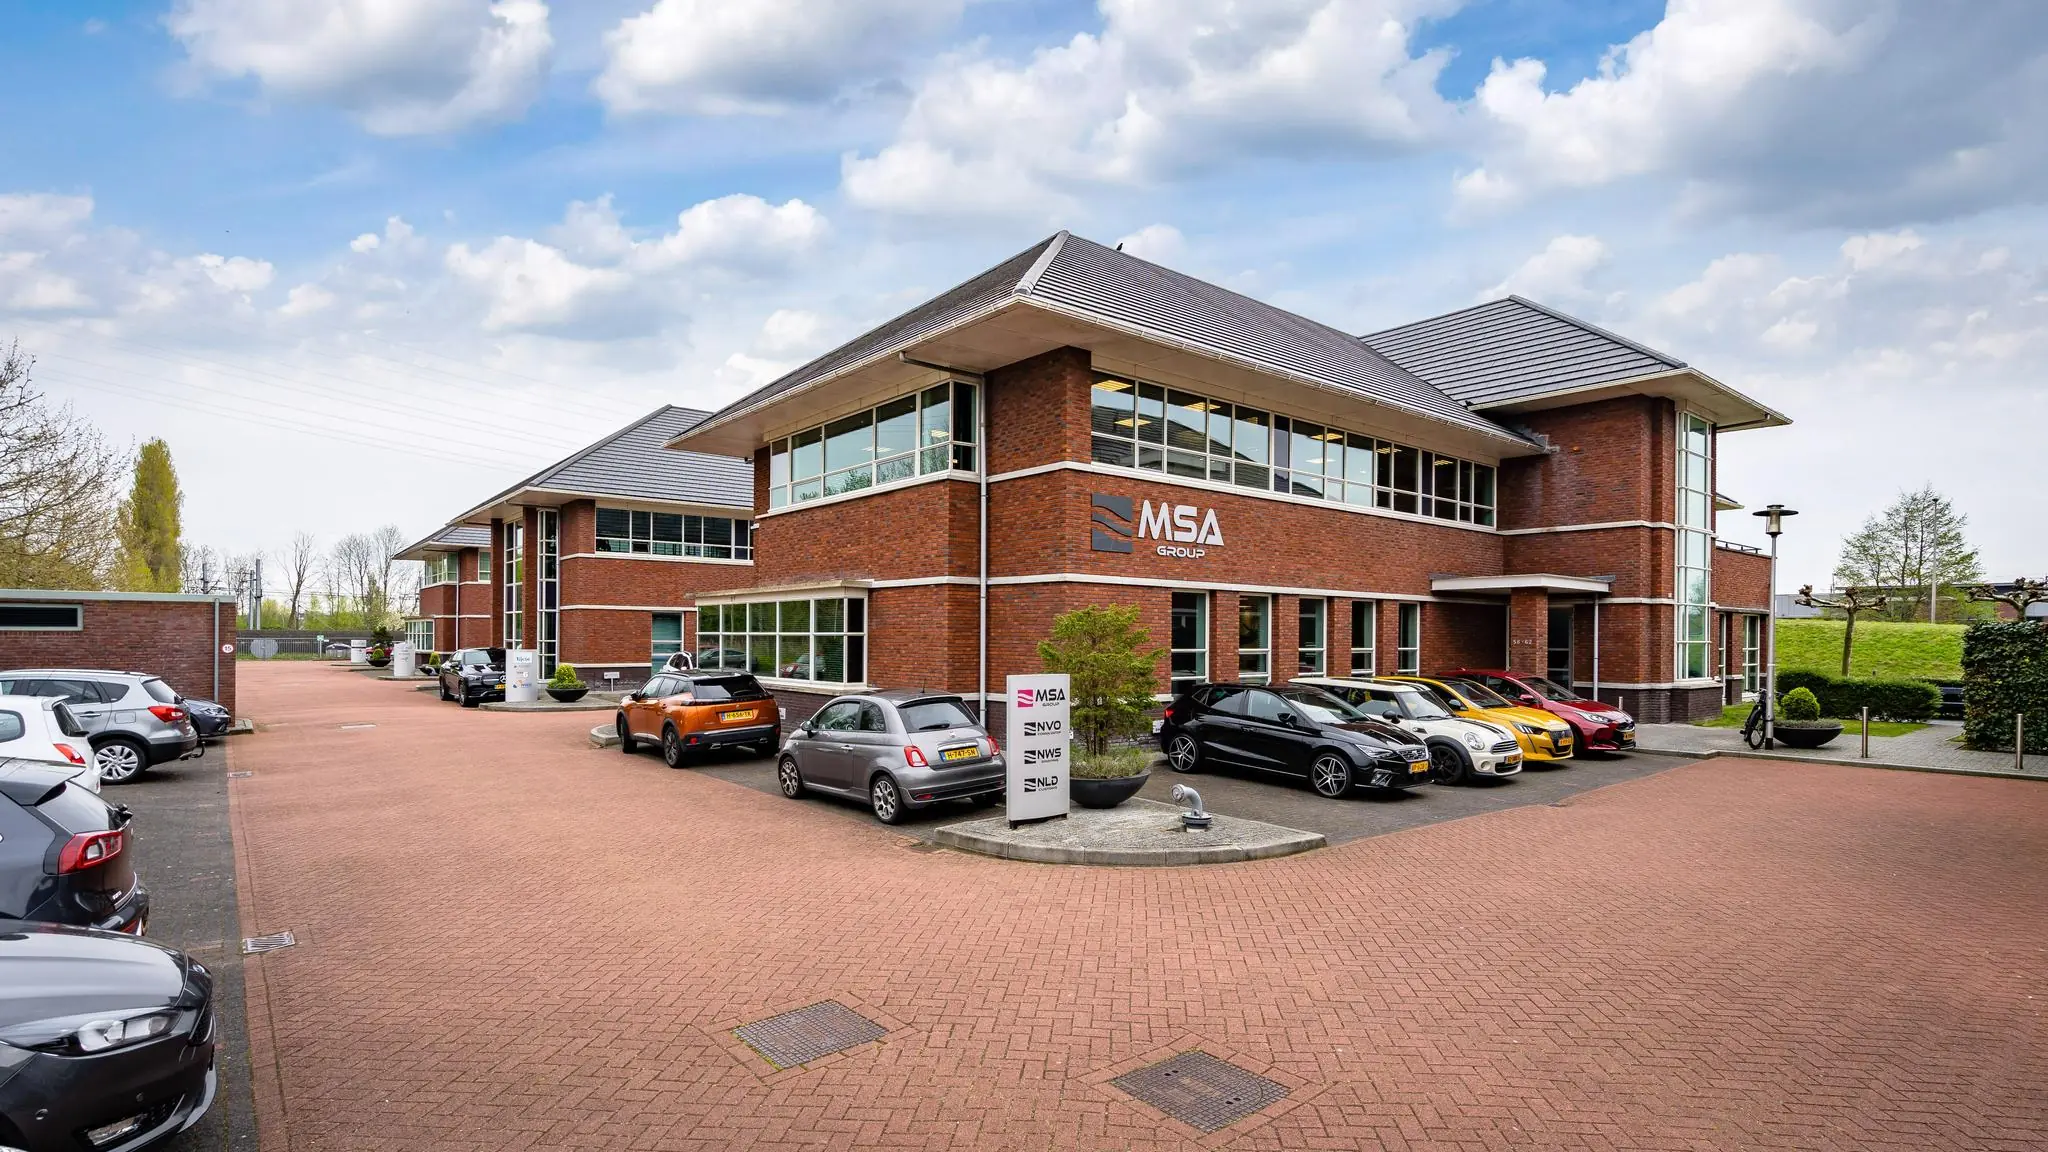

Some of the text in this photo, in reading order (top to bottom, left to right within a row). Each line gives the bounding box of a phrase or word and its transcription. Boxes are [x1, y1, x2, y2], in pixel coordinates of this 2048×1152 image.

[1138, 499, 1224, 546] MSA
[1156, 545, 1206, 559] GROUP
[1035, 688, 1065, 702] MSA
[1037, 720, 1062, 732] NVO
[947, 749, 976, 759] H-747-SN
[1037, 747, 1062, 760] NWS
[1037, 775, 1059, 787] NLD
